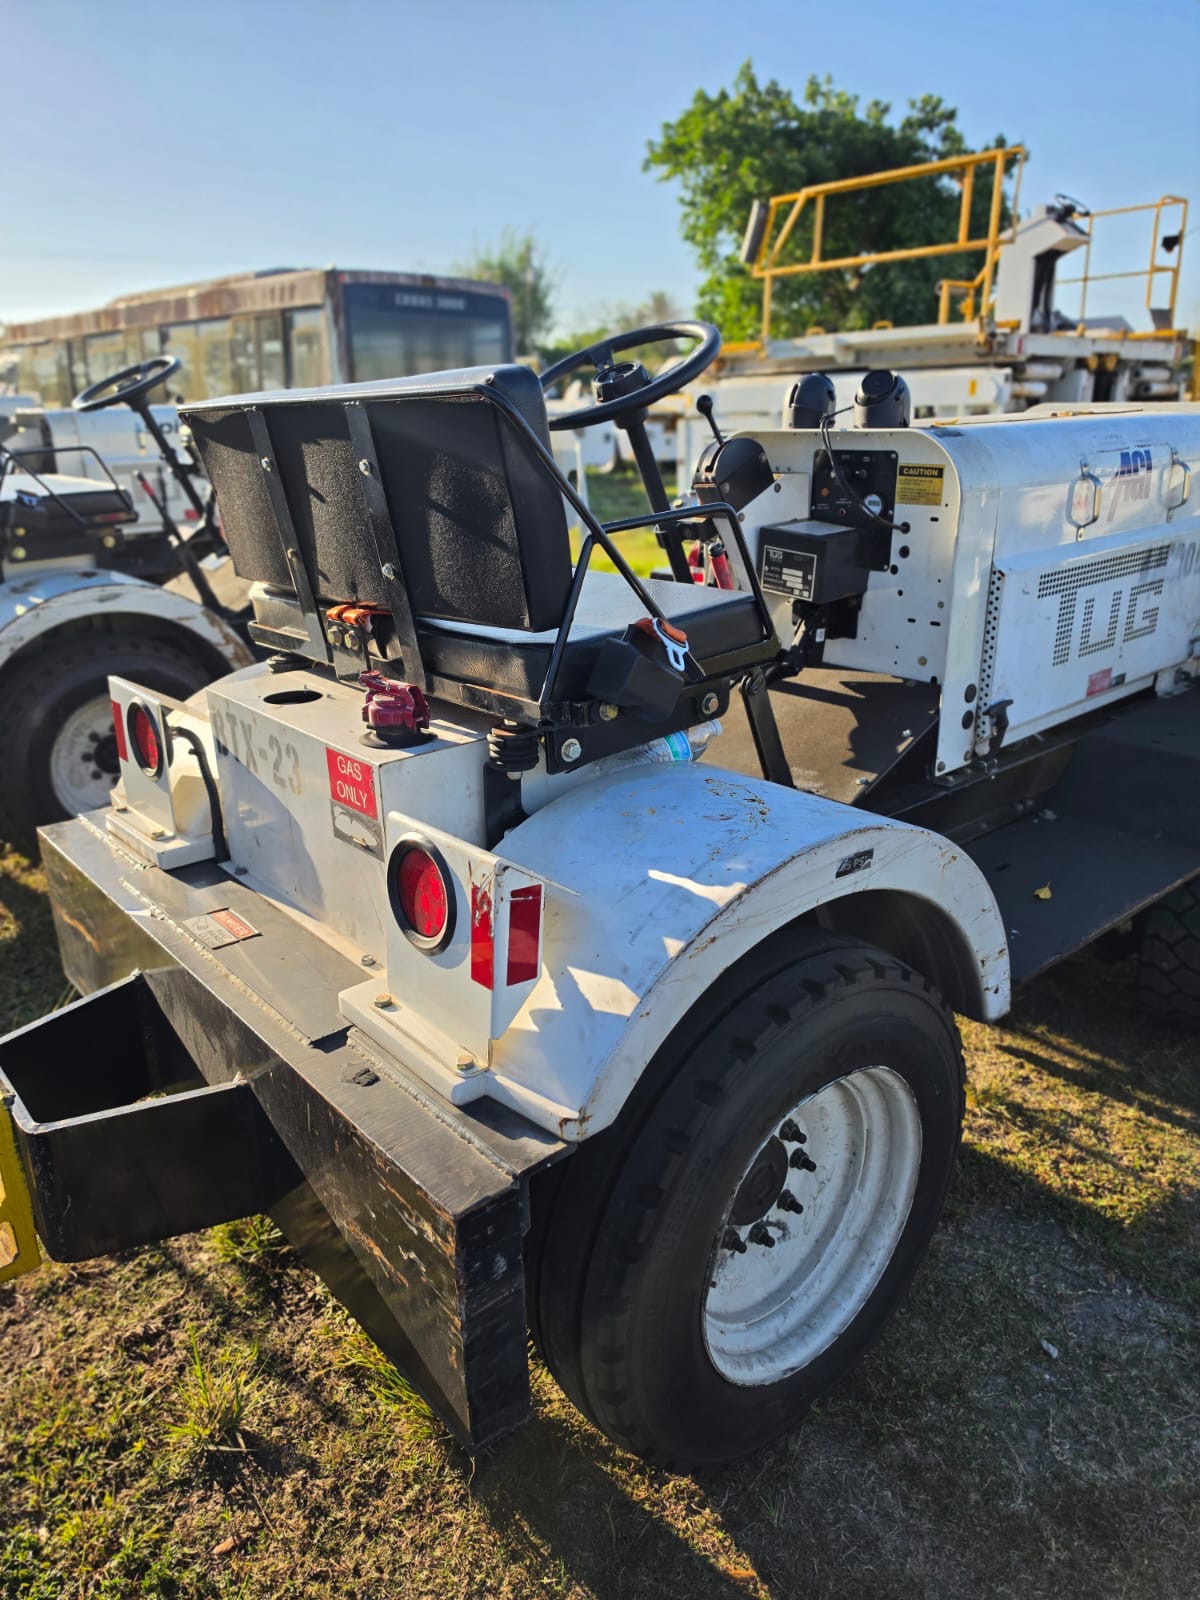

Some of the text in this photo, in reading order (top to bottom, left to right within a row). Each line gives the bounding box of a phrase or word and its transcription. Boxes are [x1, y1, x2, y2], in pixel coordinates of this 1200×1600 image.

[903, 467, 938, 477] CAUTION
[1038, 544, 1170, 667] TUG
[337, 756, 362, 782] GAS
[336, 781, 368, 808] ONLY
